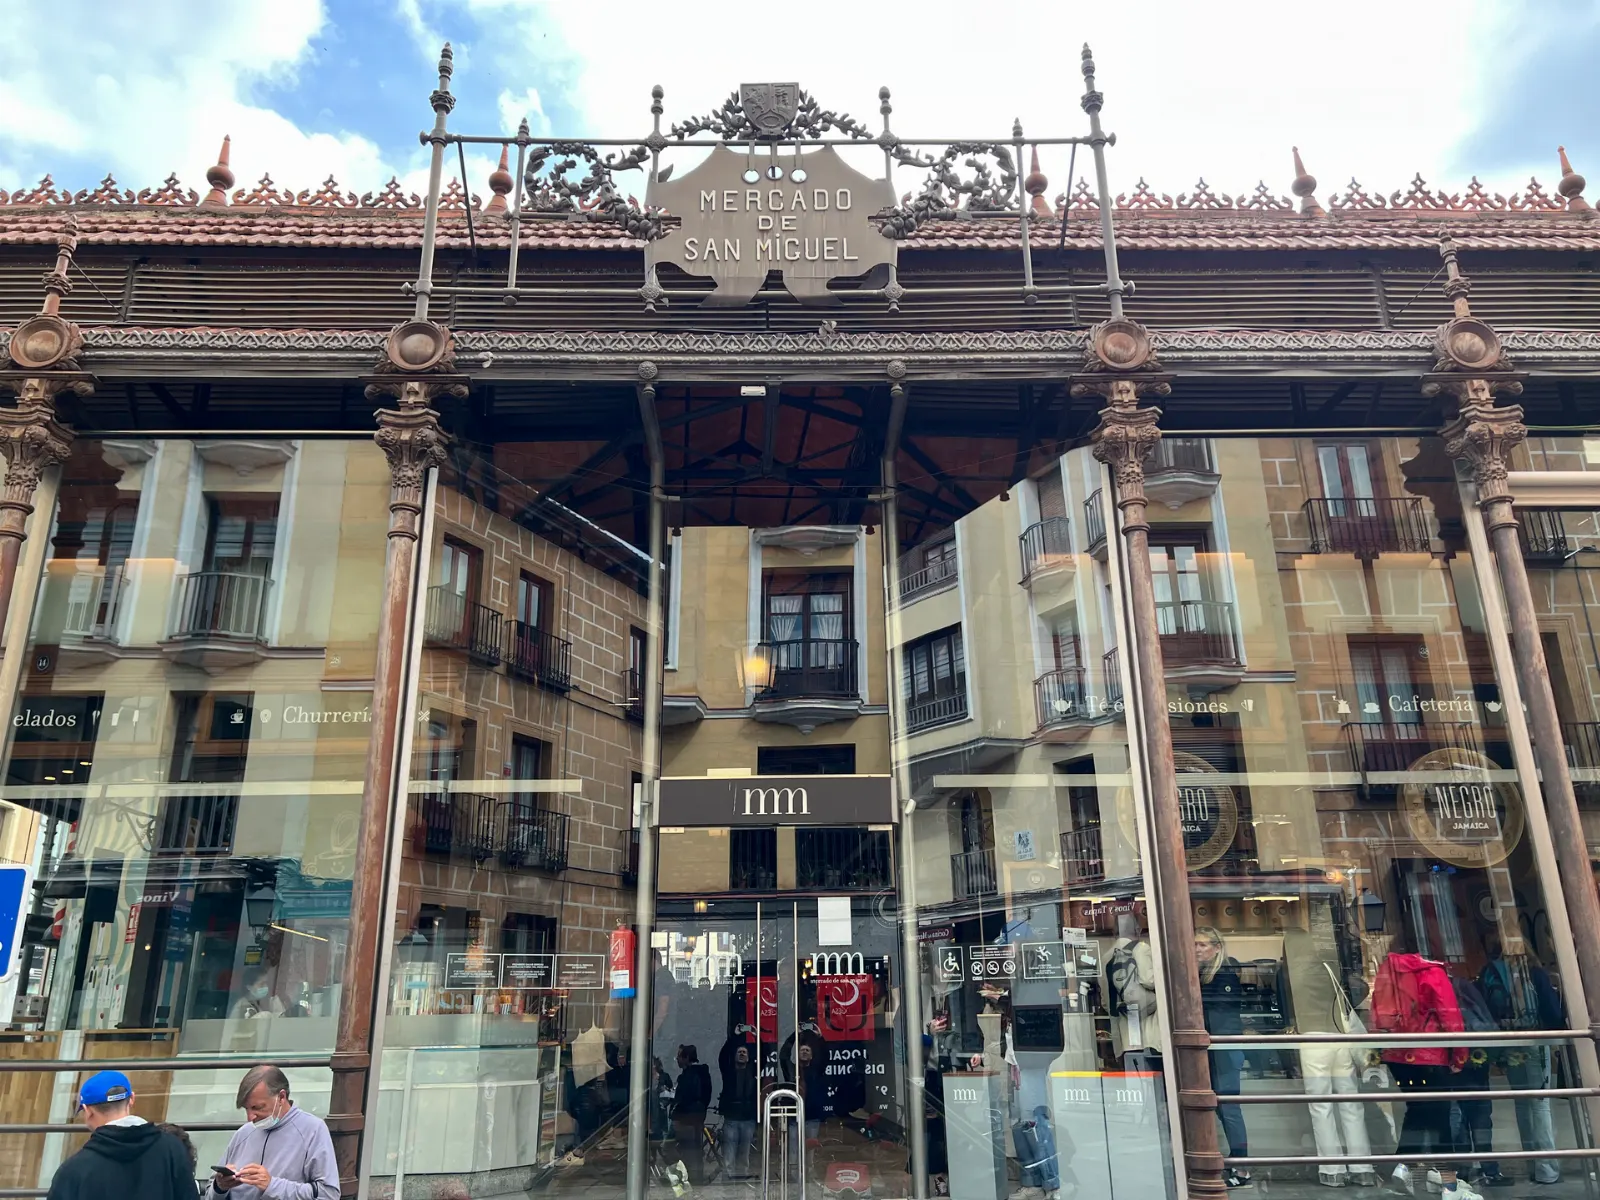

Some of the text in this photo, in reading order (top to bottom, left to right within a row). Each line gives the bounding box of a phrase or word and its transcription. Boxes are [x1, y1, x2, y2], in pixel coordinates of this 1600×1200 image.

[700, 189, 852, 212] MERCADO
[758, 215, 798, 232] DE
[684, 238, 742, 262] SAN
[1168, 697, 1229, 713] siones
[1388, 695, 1475, 712] Cafetería
[12, 709, 77, 727] elados
[283, 705, 373, 724] Churrerí
[1176, 788, 1209, 821] GRO
[1435, 785, 1497, 820] NEGRO
[1452, 822, 1490, 830] JAMAICA
